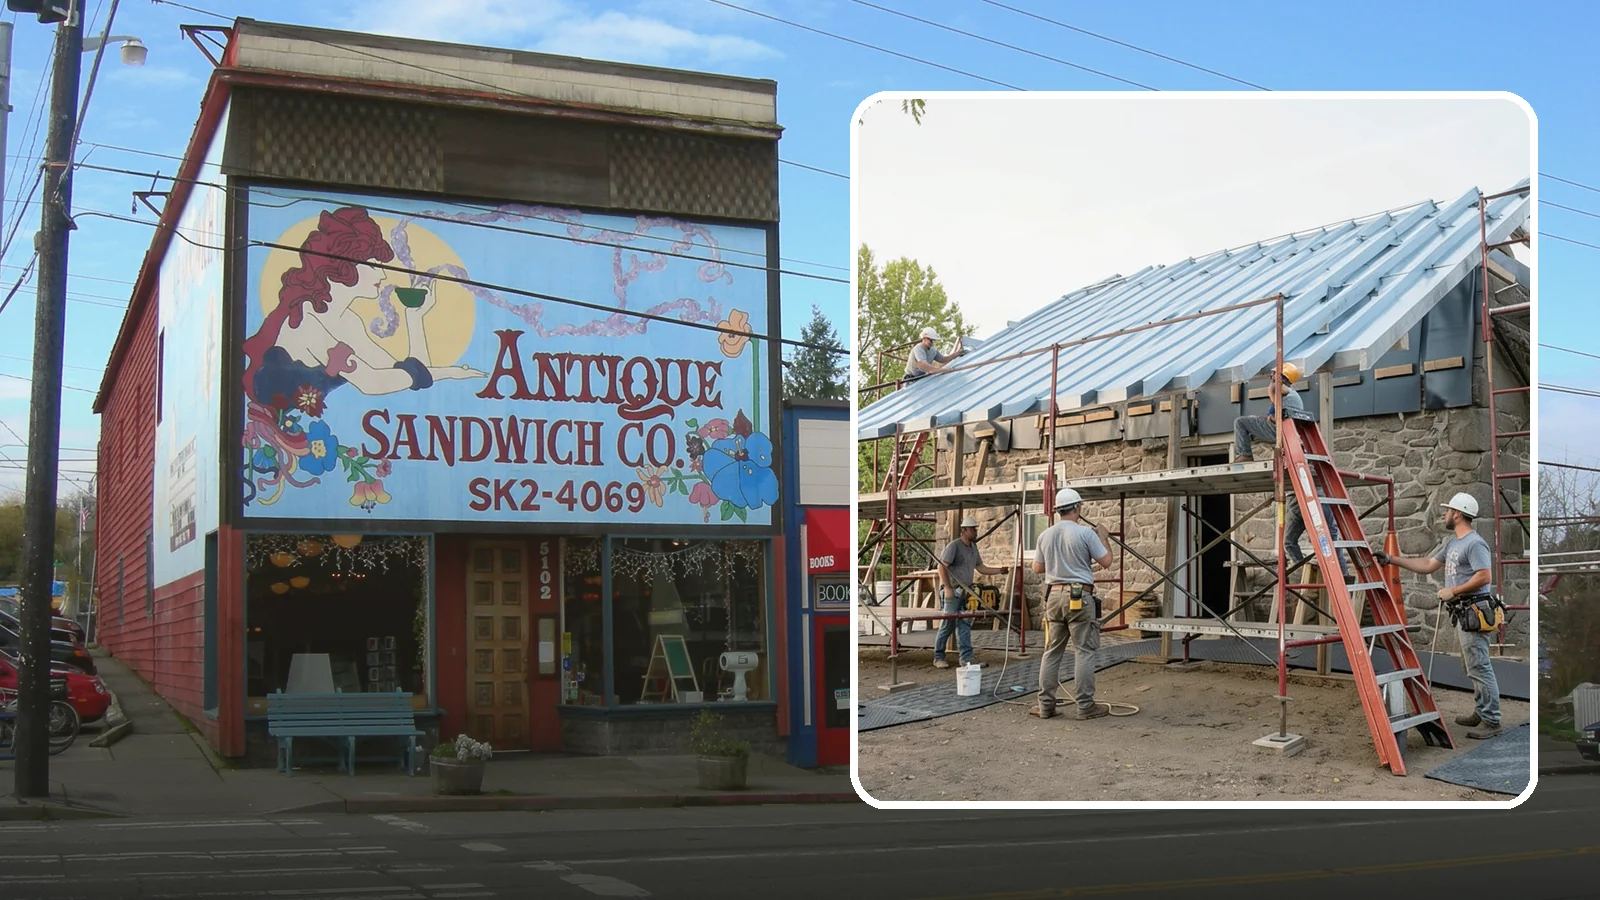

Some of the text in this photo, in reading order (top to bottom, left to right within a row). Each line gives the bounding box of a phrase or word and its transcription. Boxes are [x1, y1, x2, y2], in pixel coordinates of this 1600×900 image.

[475, 329, 723, 420] ANTIQUE
[361, 408, 685, 468] SANDWICH CO.
[468, 477, 645, 513] SK2-4069
[540, 541, 551, 600] 5102
[809, 555, 835, 569] BOOKS
